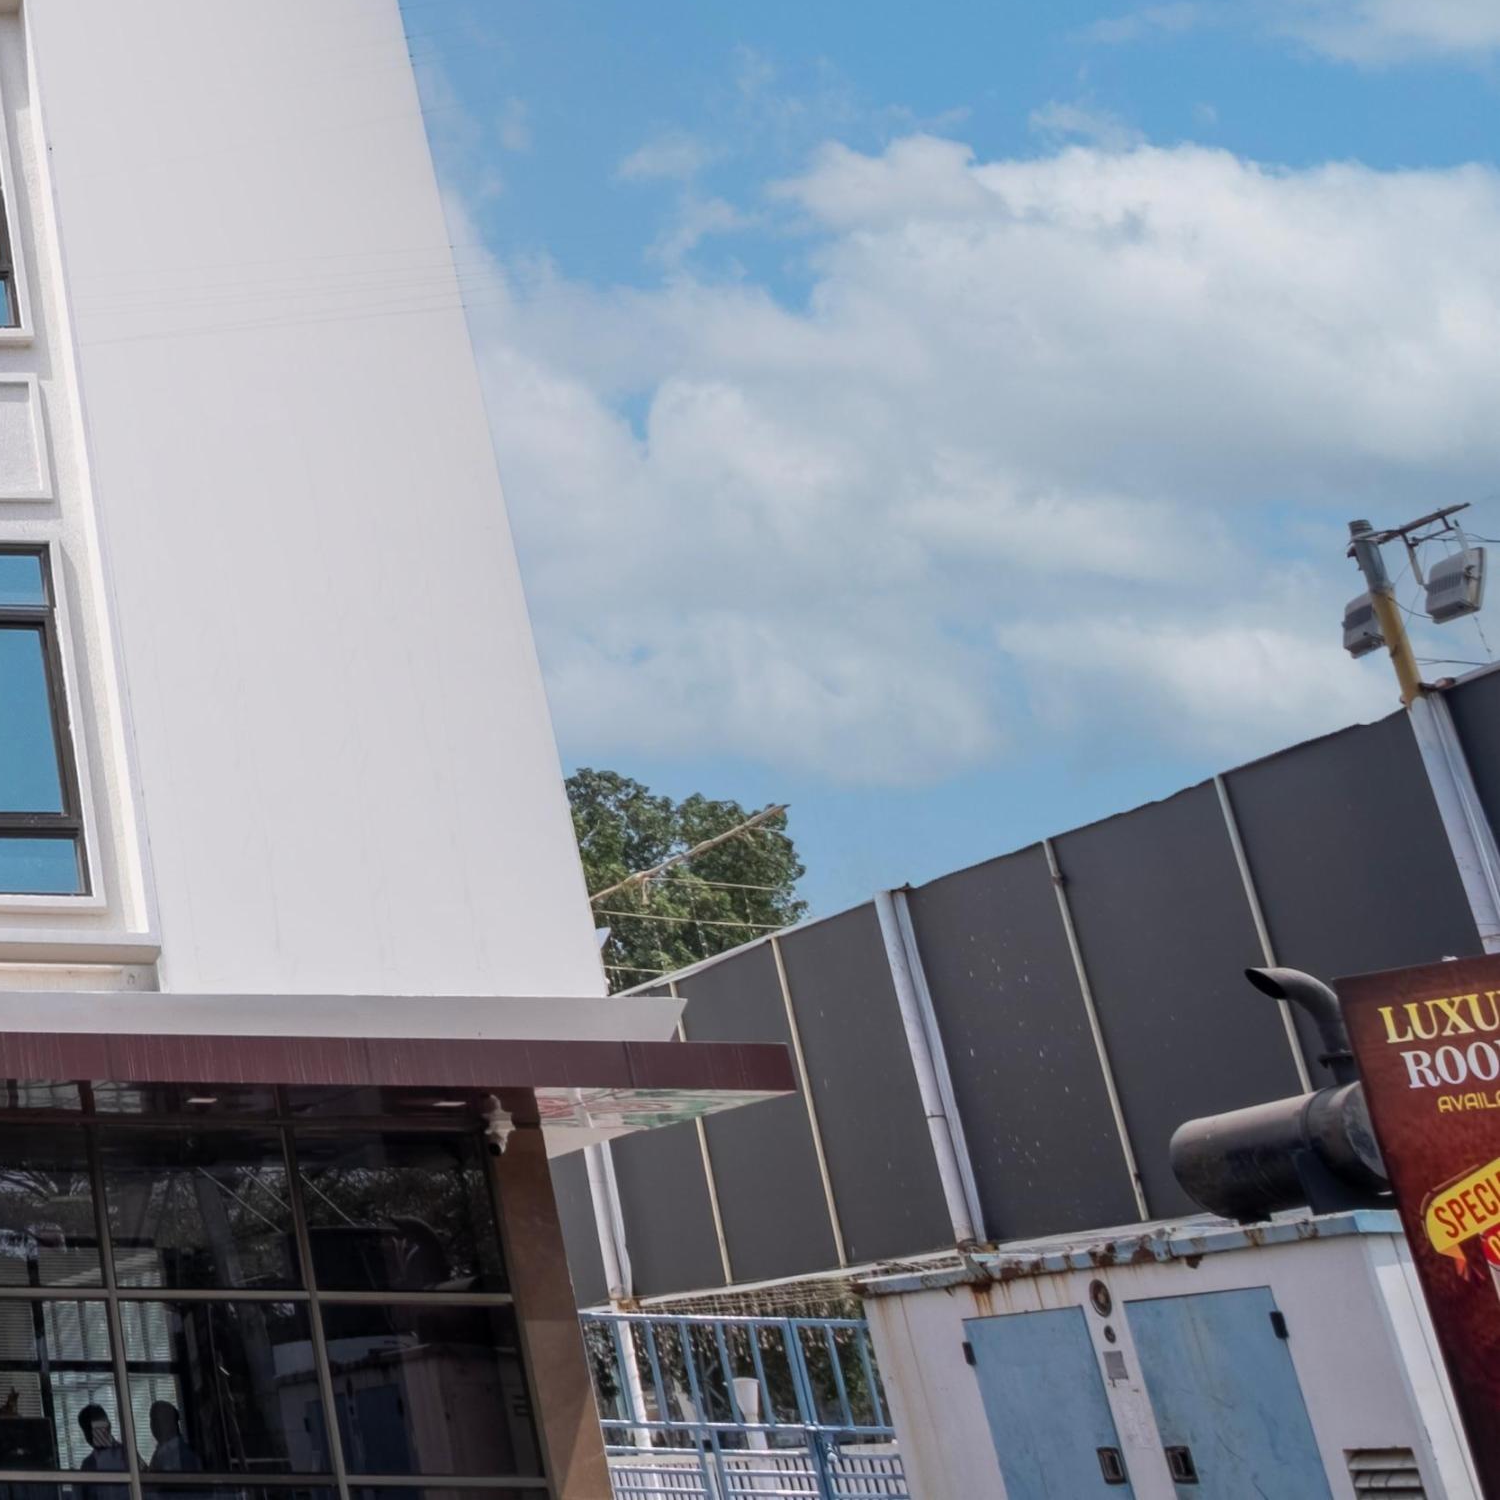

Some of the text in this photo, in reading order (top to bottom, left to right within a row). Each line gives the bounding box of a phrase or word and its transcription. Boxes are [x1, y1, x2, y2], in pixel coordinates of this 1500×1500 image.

[1377, 991, 1500, 1043] LUXU
[1400, 1040, 1500, 1089] ROO
[1434, 1172, 1500, 1238] SPECI
